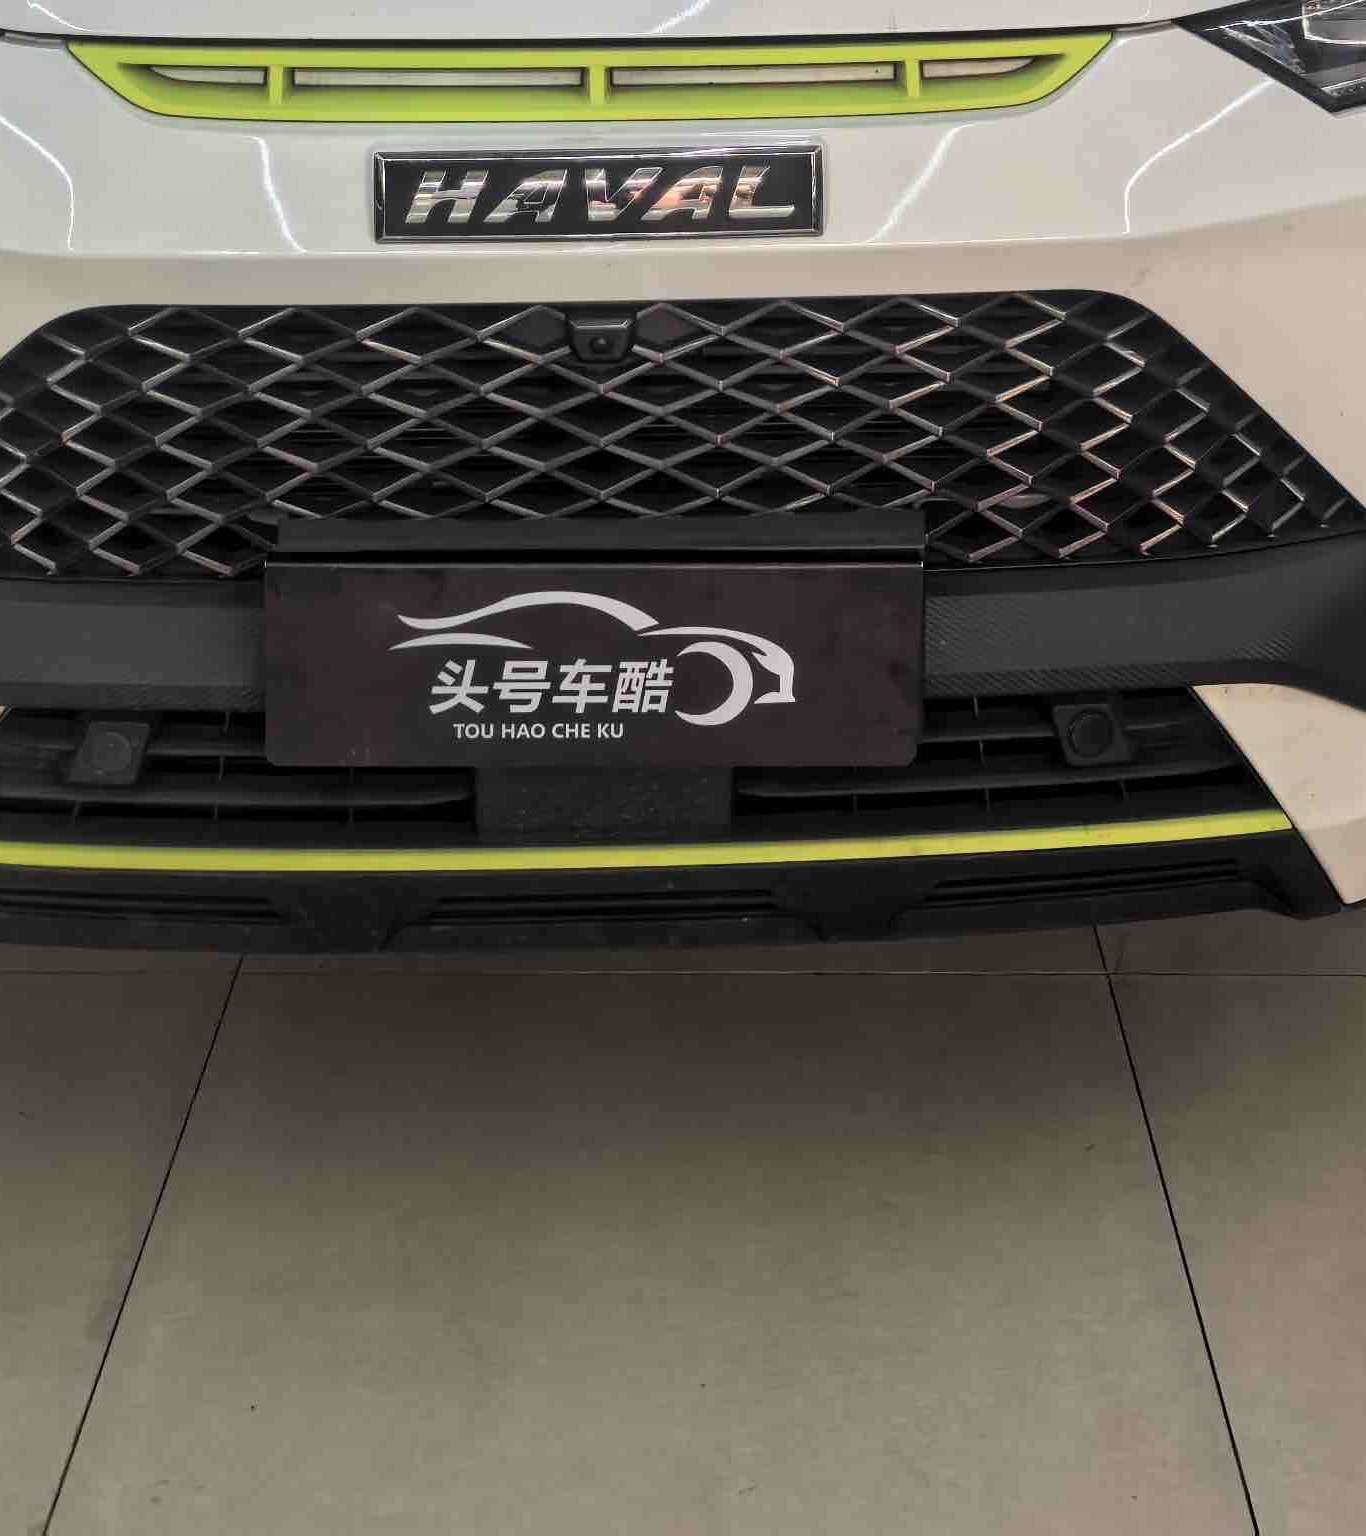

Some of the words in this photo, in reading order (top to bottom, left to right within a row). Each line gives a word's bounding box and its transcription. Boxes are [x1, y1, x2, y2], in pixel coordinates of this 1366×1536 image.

[404, 164, 797, 225] HAVAL
[428, 657, 675, 715] 头号车酷
[452, 721, 495, 740] TOU
[500, 721, 545, 740] HAO
[551, 721, 591, 740] CHE
[598, 721, 625, 740] KU
